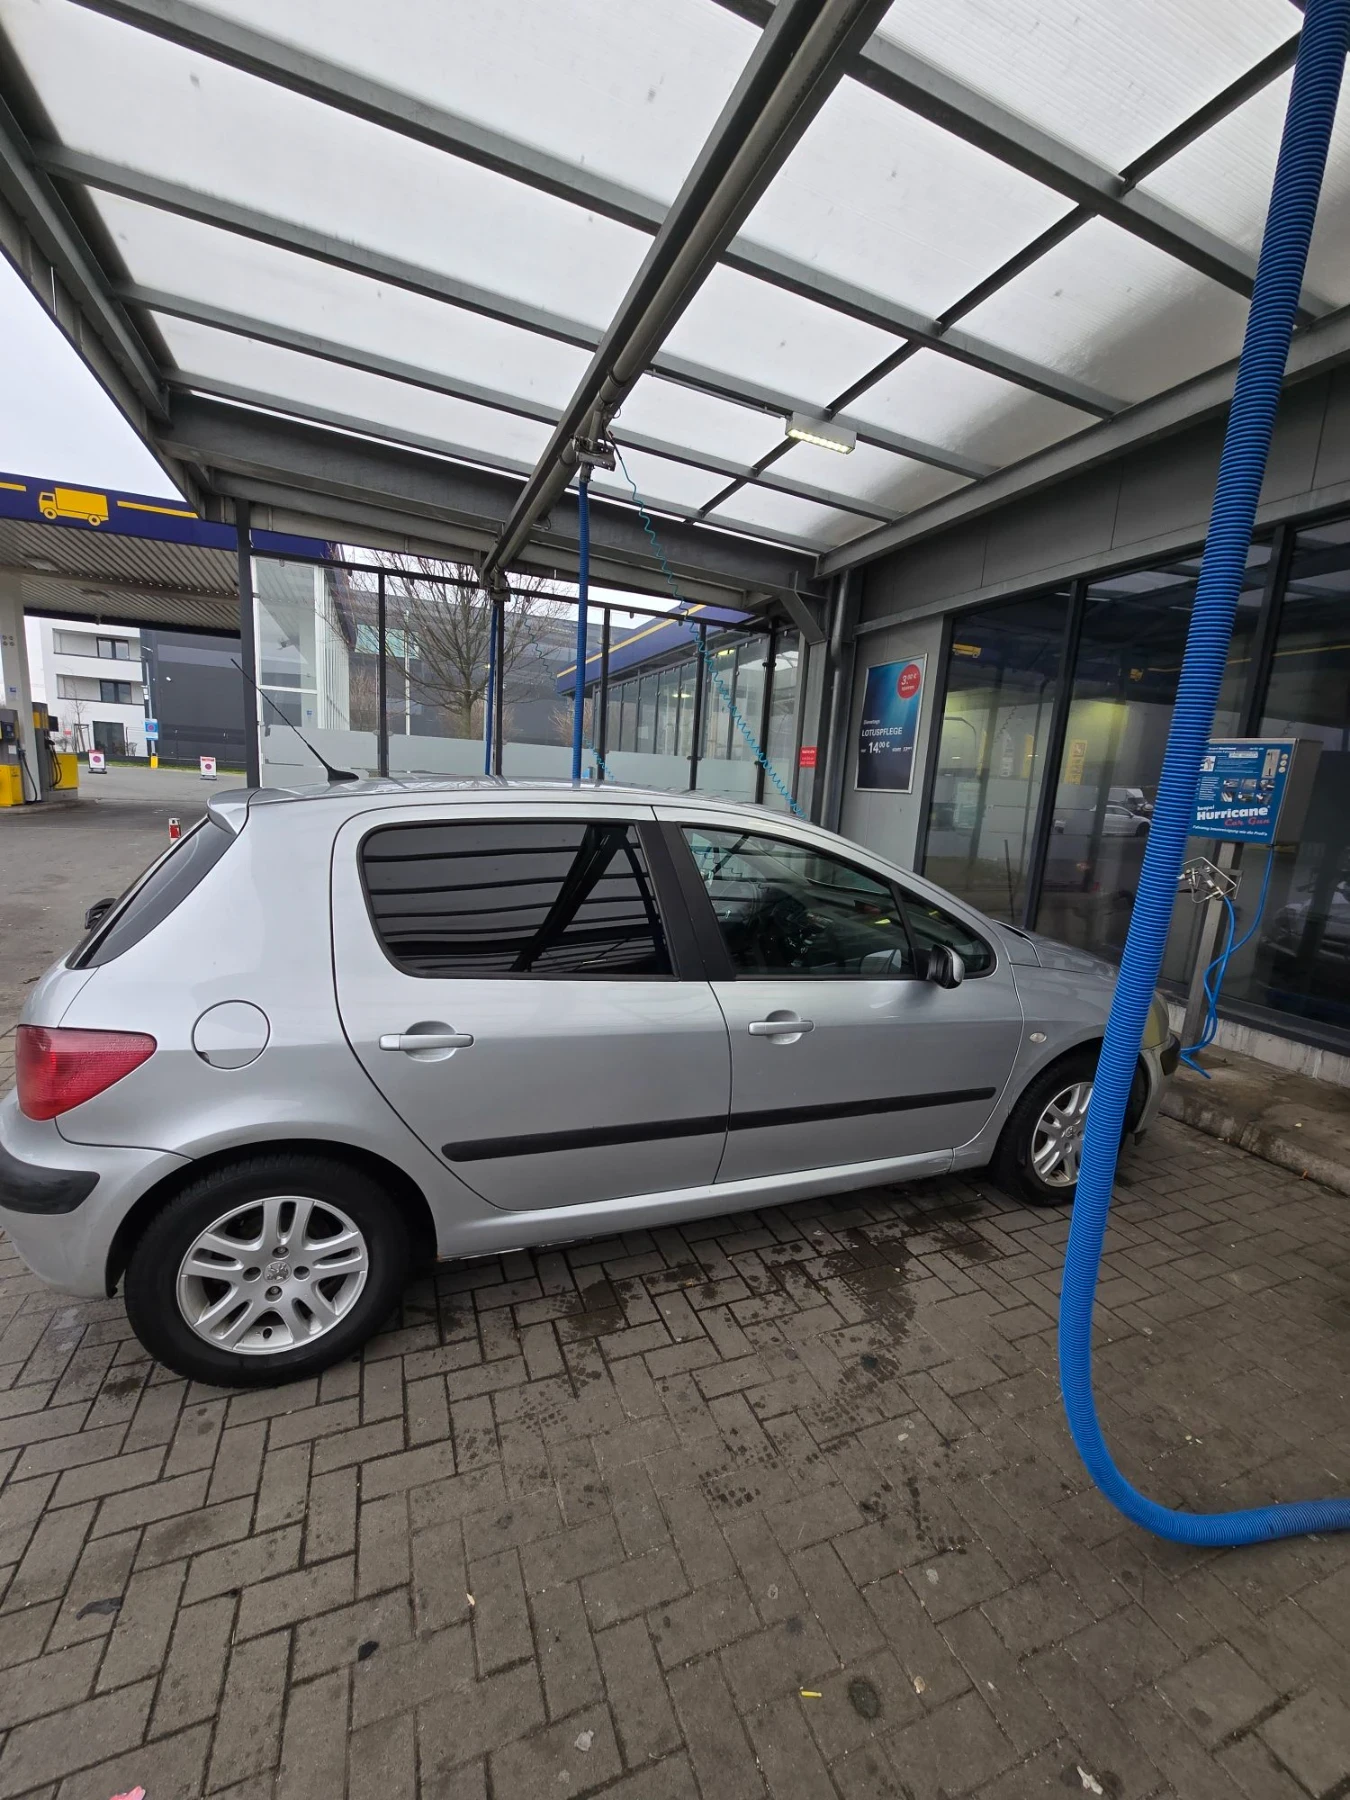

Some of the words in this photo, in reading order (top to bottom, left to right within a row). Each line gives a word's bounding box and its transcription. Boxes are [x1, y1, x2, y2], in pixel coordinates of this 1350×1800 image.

[862, 727, 902, 736] LOTUSPFLEGE
[1196, 807, 1268, 820] Hurricane
[1224, 818, 1244, 826] Car
[1248, 816, 1270, 824] Gun
